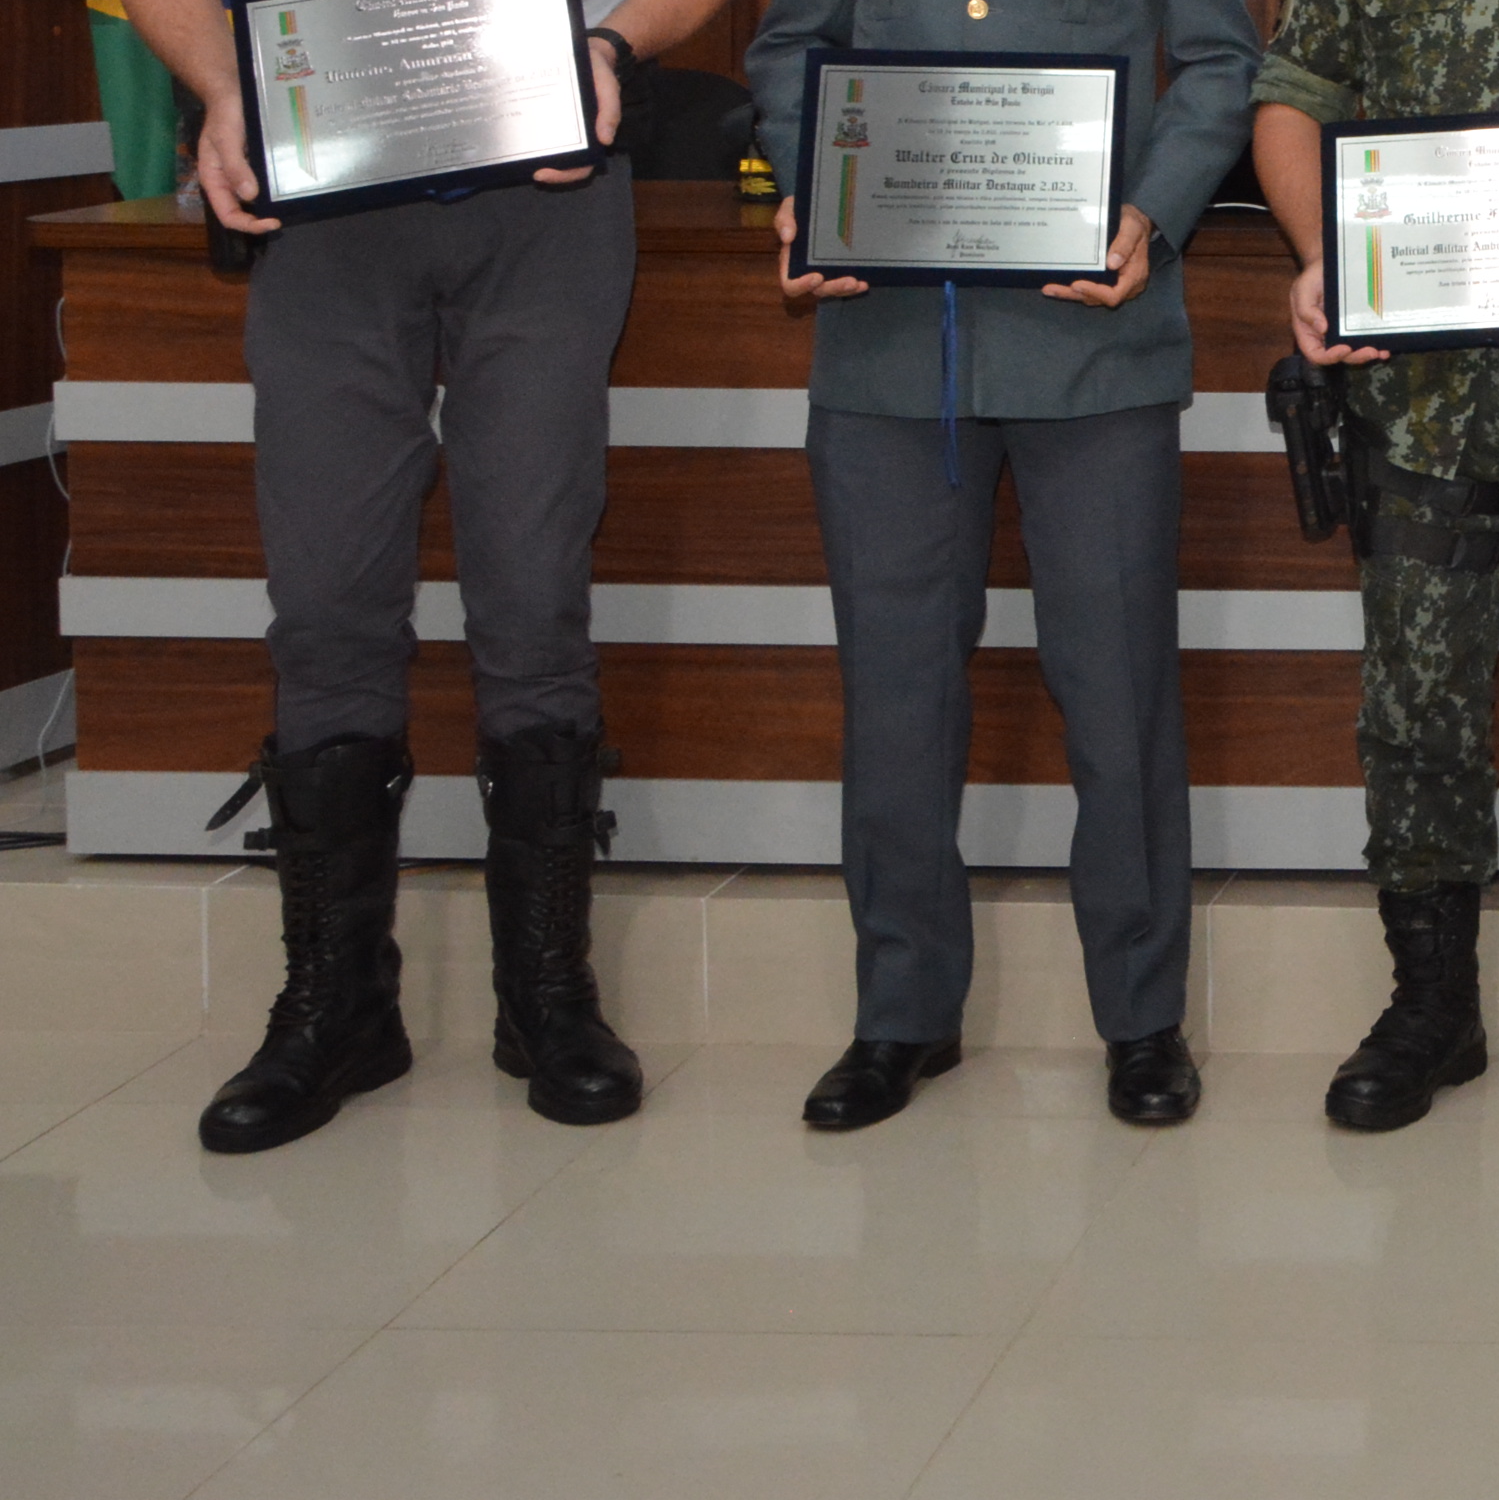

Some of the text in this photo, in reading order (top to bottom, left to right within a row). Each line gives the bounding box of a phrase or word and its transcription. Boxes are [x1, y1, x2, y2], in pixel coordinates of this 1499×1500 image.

[958, 82, 1004, 94] Municipal
[1008, 82, 1017, 93] de
[896, 150, 1073, 165] Walter Cruz de Oliveira
[884, 177, 938, 189] Bombeiro
[943, 178, 981, 191] Militar
[986, 179, 1035, 192] Destaque
[1403, 210, 1481, 227] Guilherme
[1391, 243, 1429, 259] Policial
[1433, 243, 1468, 255] Militar
